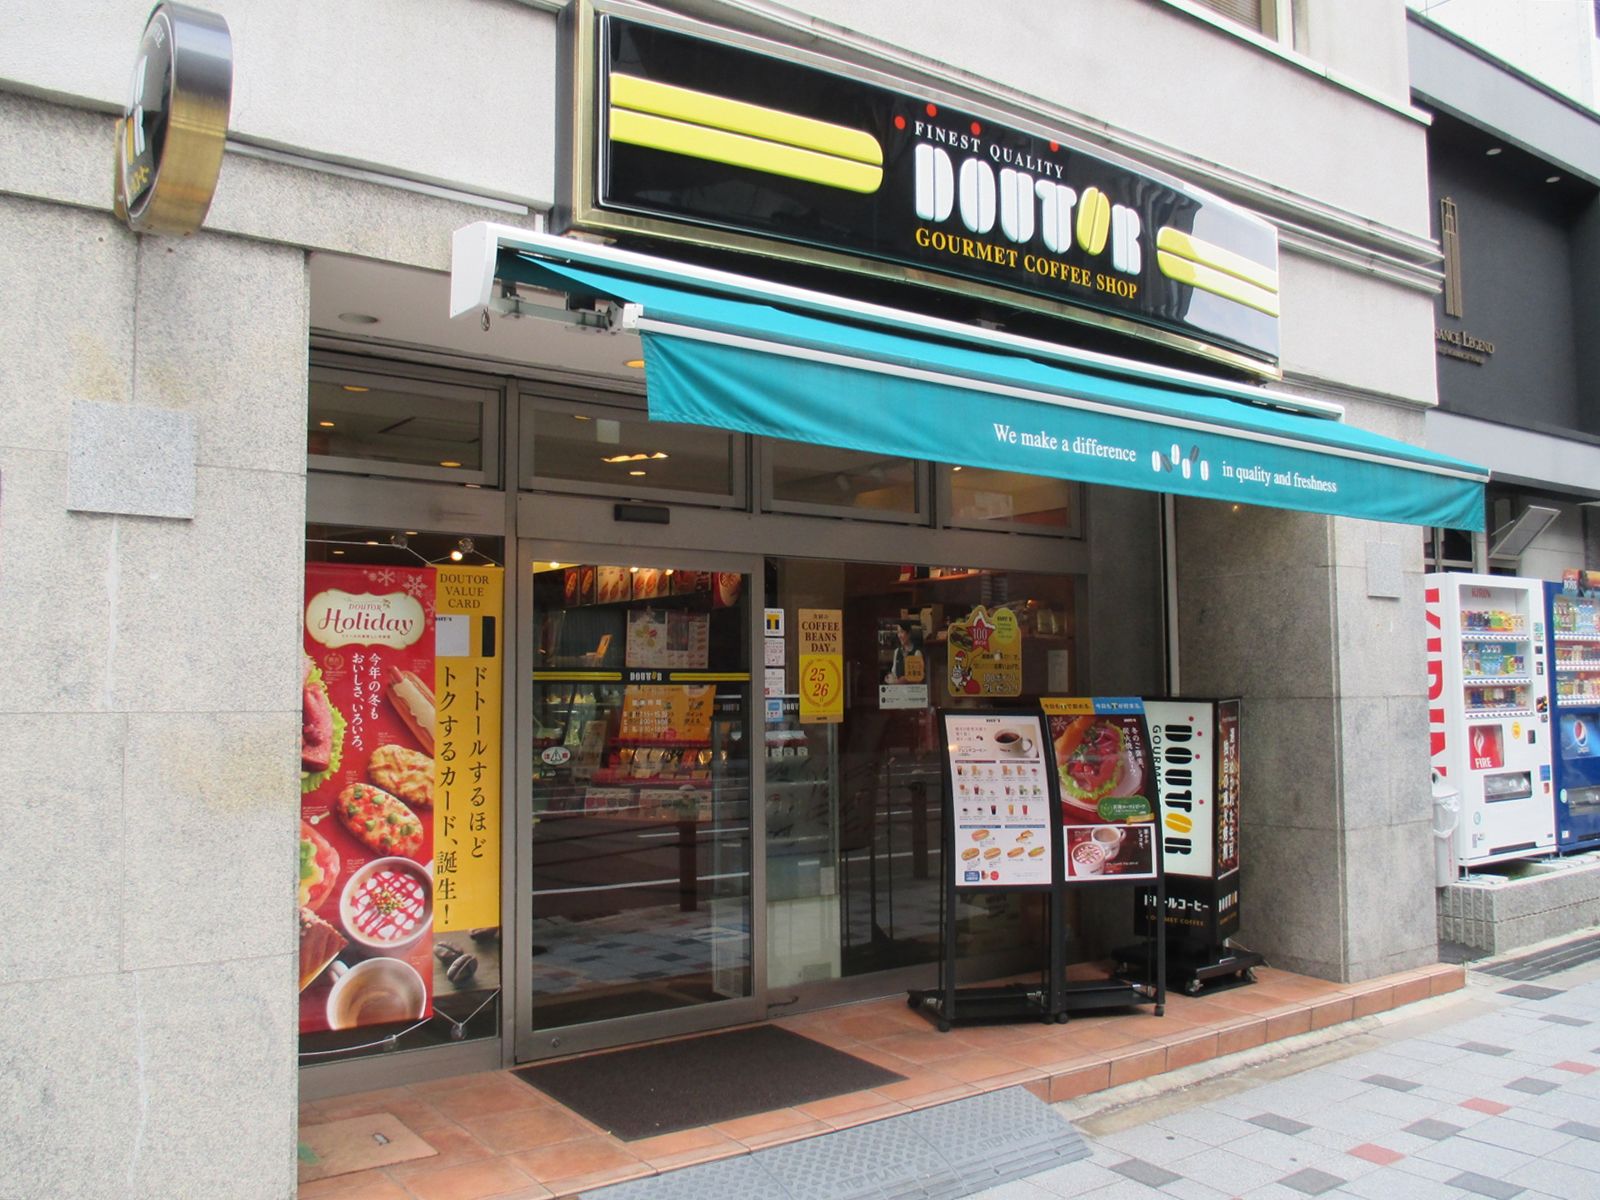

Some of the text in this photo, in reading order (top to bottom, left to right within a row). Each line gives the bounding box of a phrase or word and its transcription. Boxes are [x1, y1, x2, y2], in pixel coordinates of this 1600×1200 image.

[915, 120, 1064, 179] FINEST QUALITY
[915, 143, 1142, 276] DOUTOR
[915, 228, 1138, 299] GOURMET COFFEE SHOP
[993, 423, 1338, 493] We make a difference in quality and freshness
[440, 574, 489, 585] DOUTOR
[446, 586, 484, 597] VALUE
[348, 603, 382, 611] DOUTOR
[448, 599, 481, 609] CARD
[318, 608, 414, 636] Holiday
[801, 621, 840, 632] COFFEE
[804, 631, 837, 642] BEANS
[972, 628, 988, 641] 100
[810, 643, 832, 653] DAY
[630, 672, 662, 682] DOUTOR
[809, 668, 826, 682] 25
[368, 652, 382, 720] 今年の冬も
[813, 683, 829, 698] 26
[351, 652, 365, 752] おいしさ、いろいろ。
[468, 666, 488, 859] ドトールするほど
[1474, 757, 1492, 768] FIRE
[1164, 724, 1192, 856] DOUTOR
